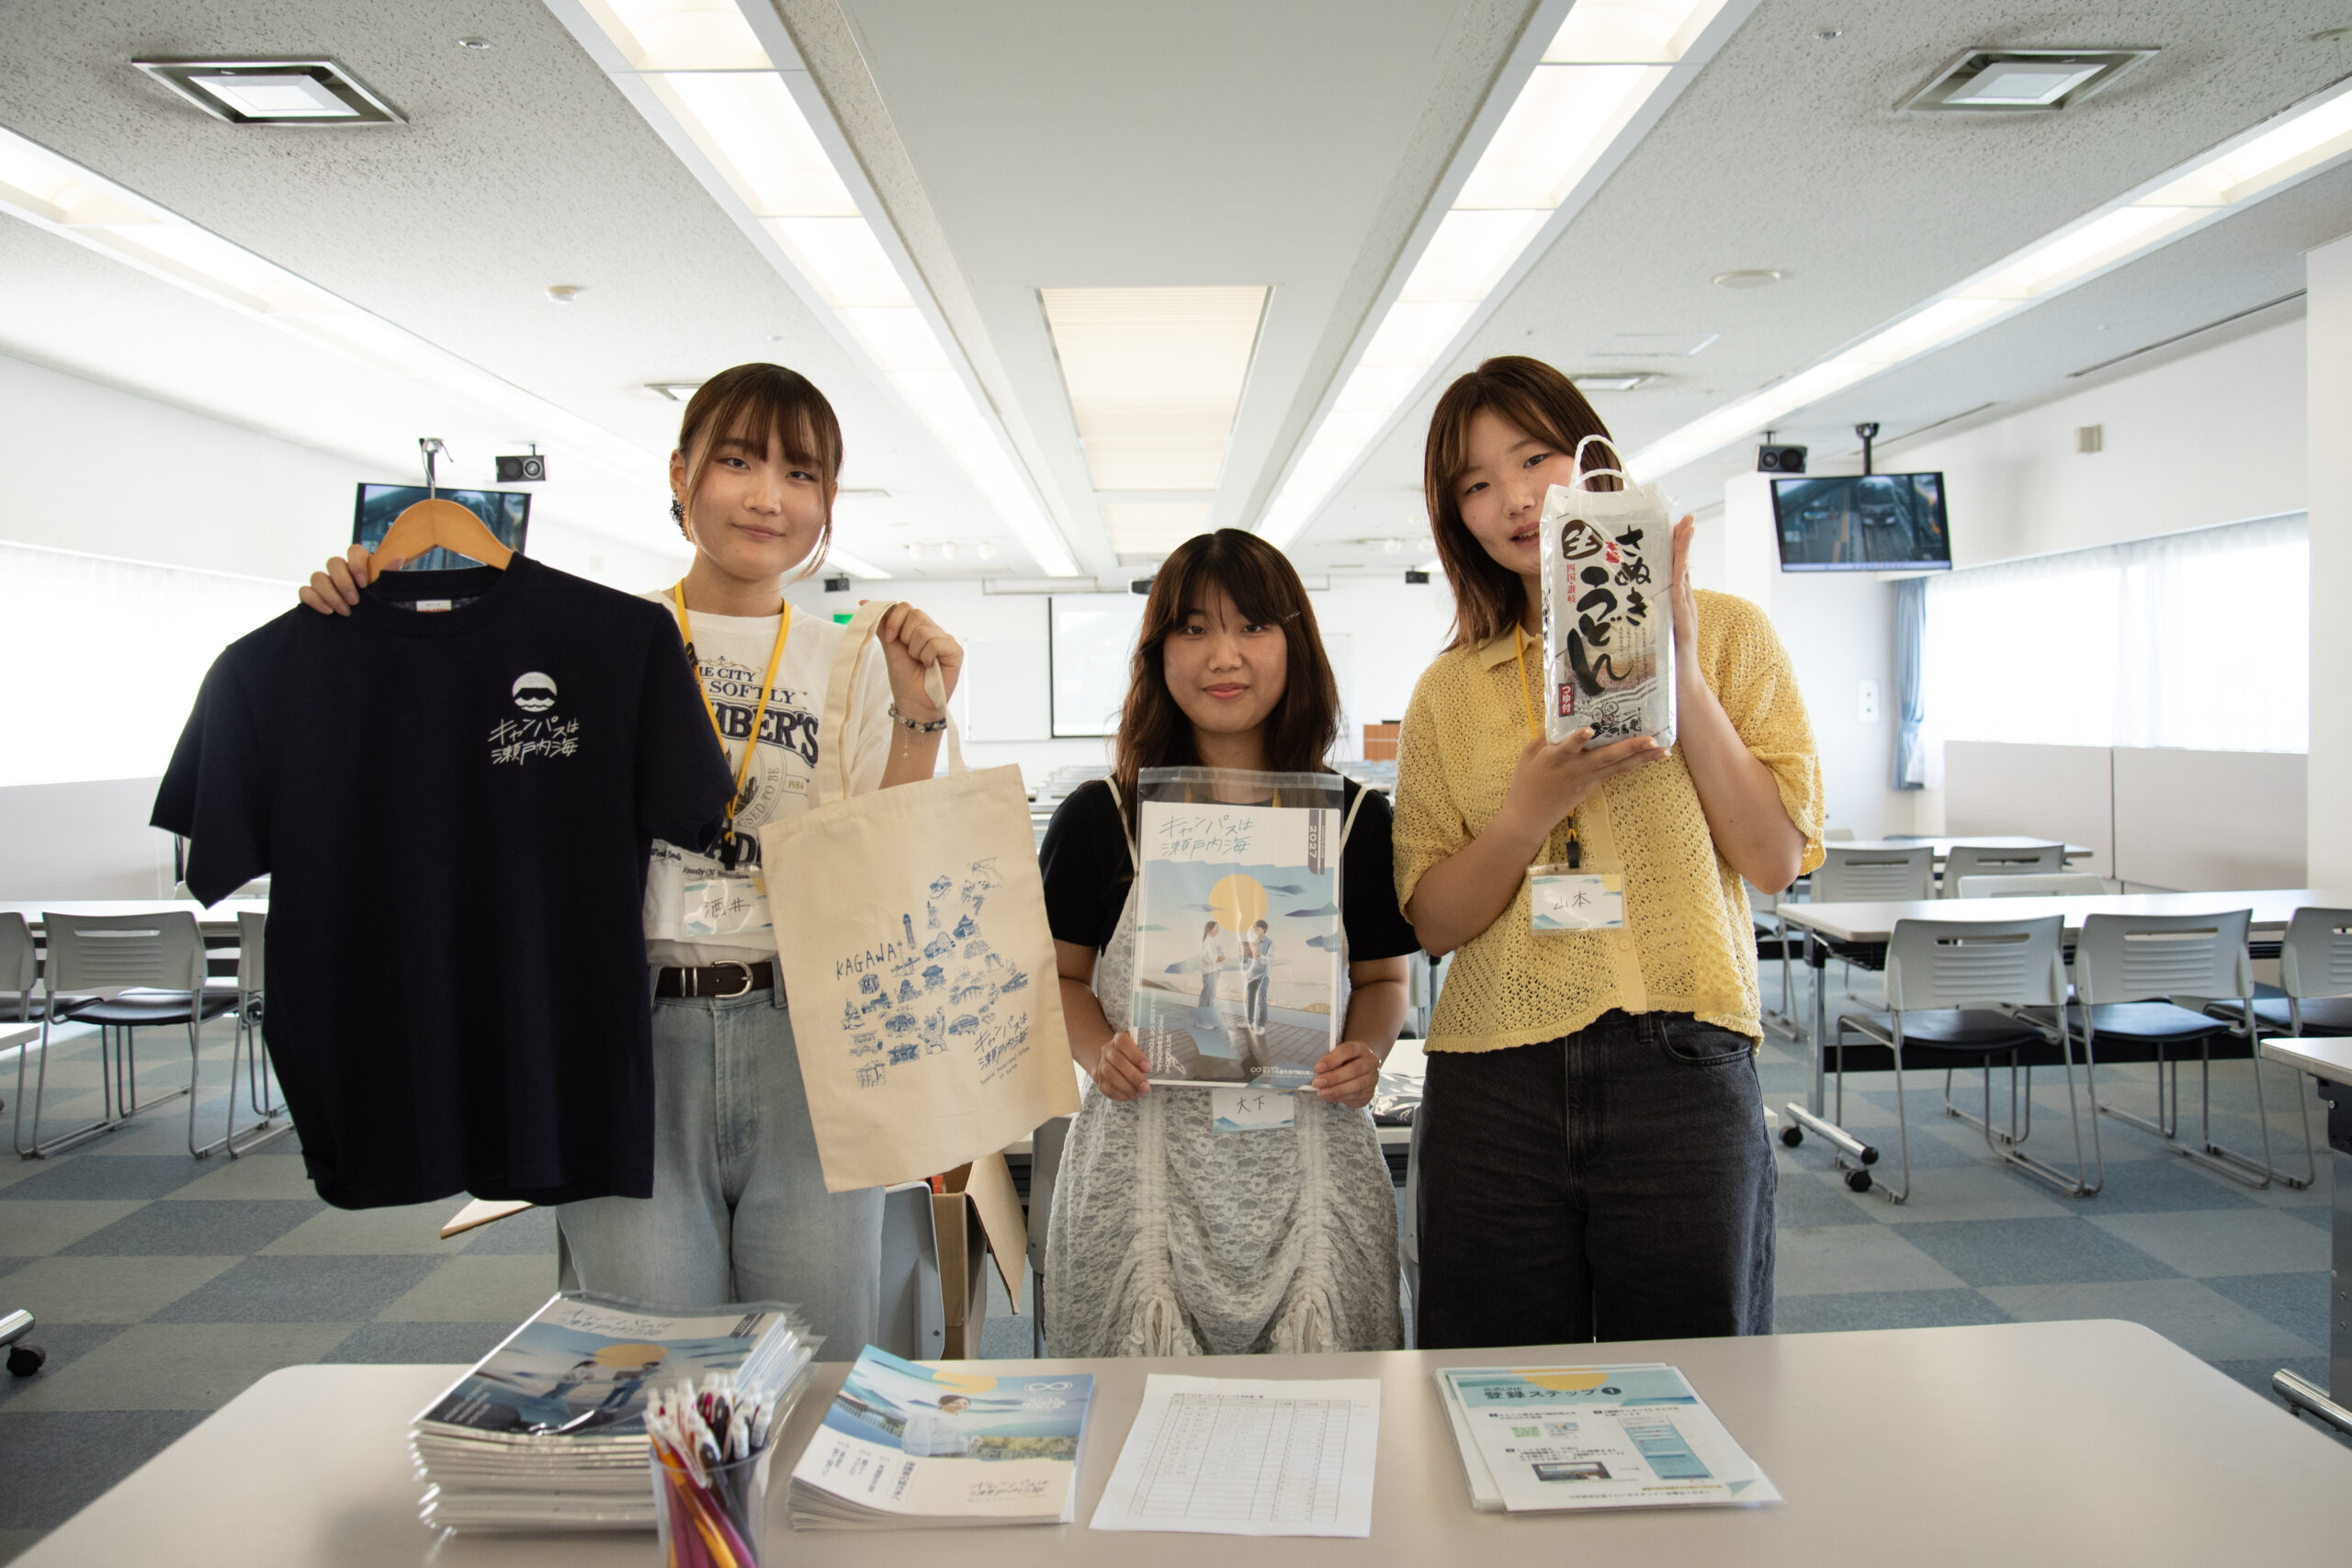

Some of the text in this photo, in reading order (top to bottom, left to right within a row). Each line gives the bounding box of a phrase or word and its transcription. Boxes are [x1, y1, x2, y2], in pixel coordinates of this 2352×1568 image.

[1614, 525, 1652, 626] さぬき
[1566, 566, 1634, 697] うどん
[718, 668, 756, 682] CITY
[709, 681, 796, 704] SOFTLY
[1562, 685, 1572, 714] つゆ付
[488, 716, 580, 745] キャンパスは
[491, 738, 579, 765] 瀬戸内海
[767, 767, 780, 782] BE
[762, 785, 775, 801] TO
[1159, 815, 1253, 839] キャンパスは
[1160, 835, 1252, 860] 瀬戸内海
[1308, 825, 1317, 859] 2027
[1554, 890, 1592, 910] 山本
[836, 943, 898, 981] KAGAWA
